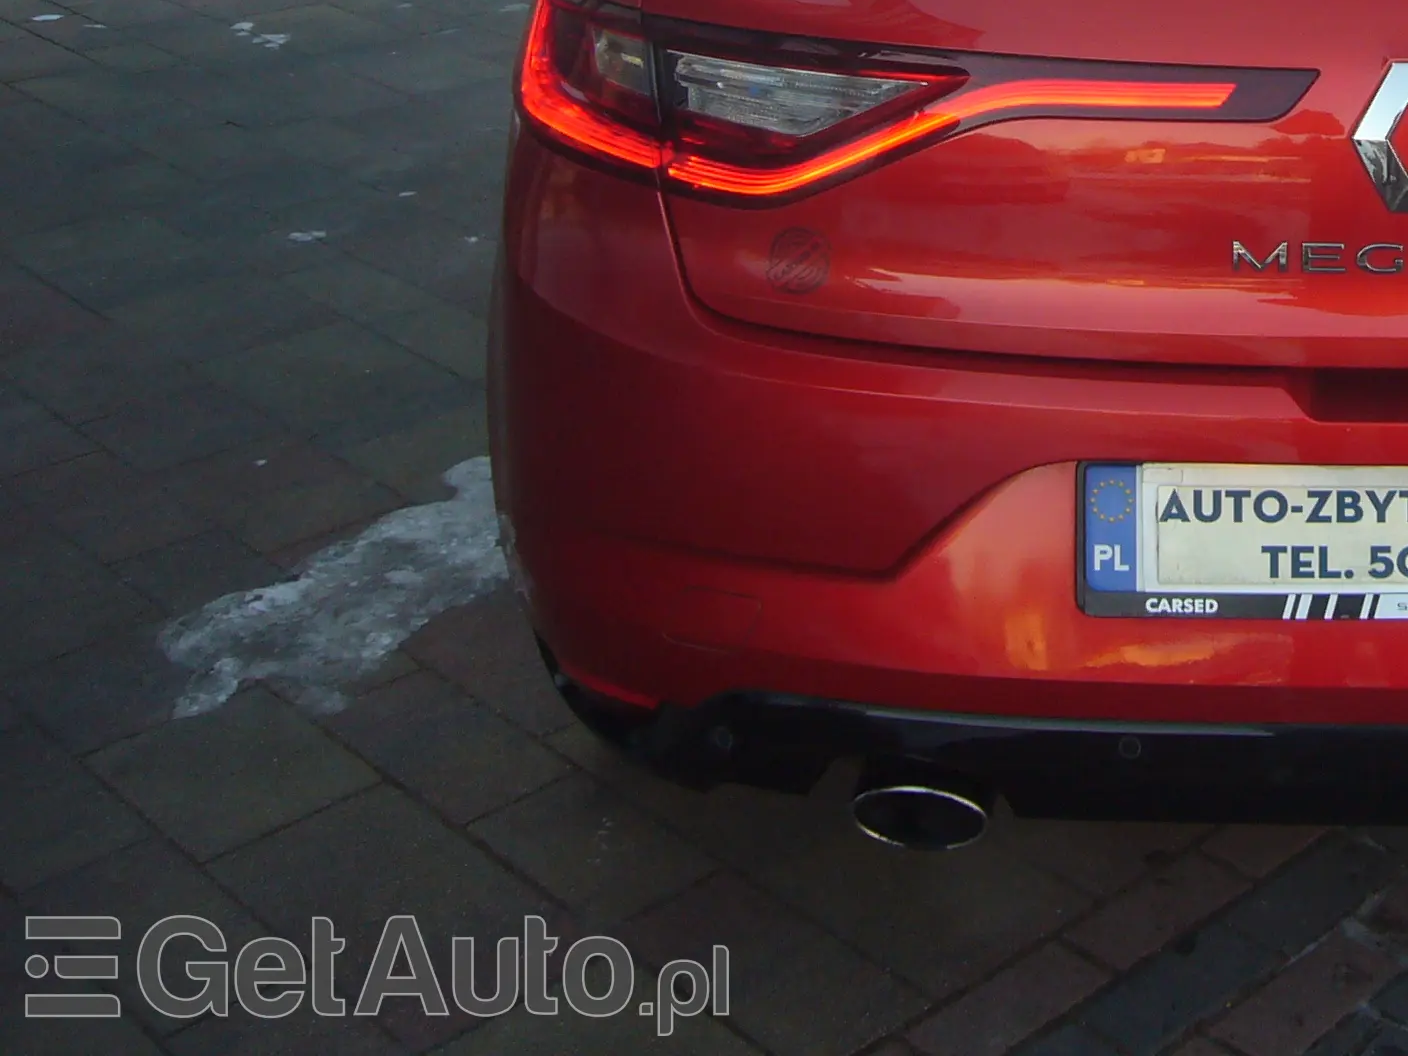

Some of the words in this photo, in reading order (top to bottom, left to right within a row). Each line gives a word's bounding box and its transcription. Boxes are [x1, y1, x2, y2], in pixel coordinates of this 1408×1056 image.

[1093, 544, 1130, 571] PL
[1261, 545, 1354, 579] TEL.
[1145, 597, 1219, 614] CARSED
